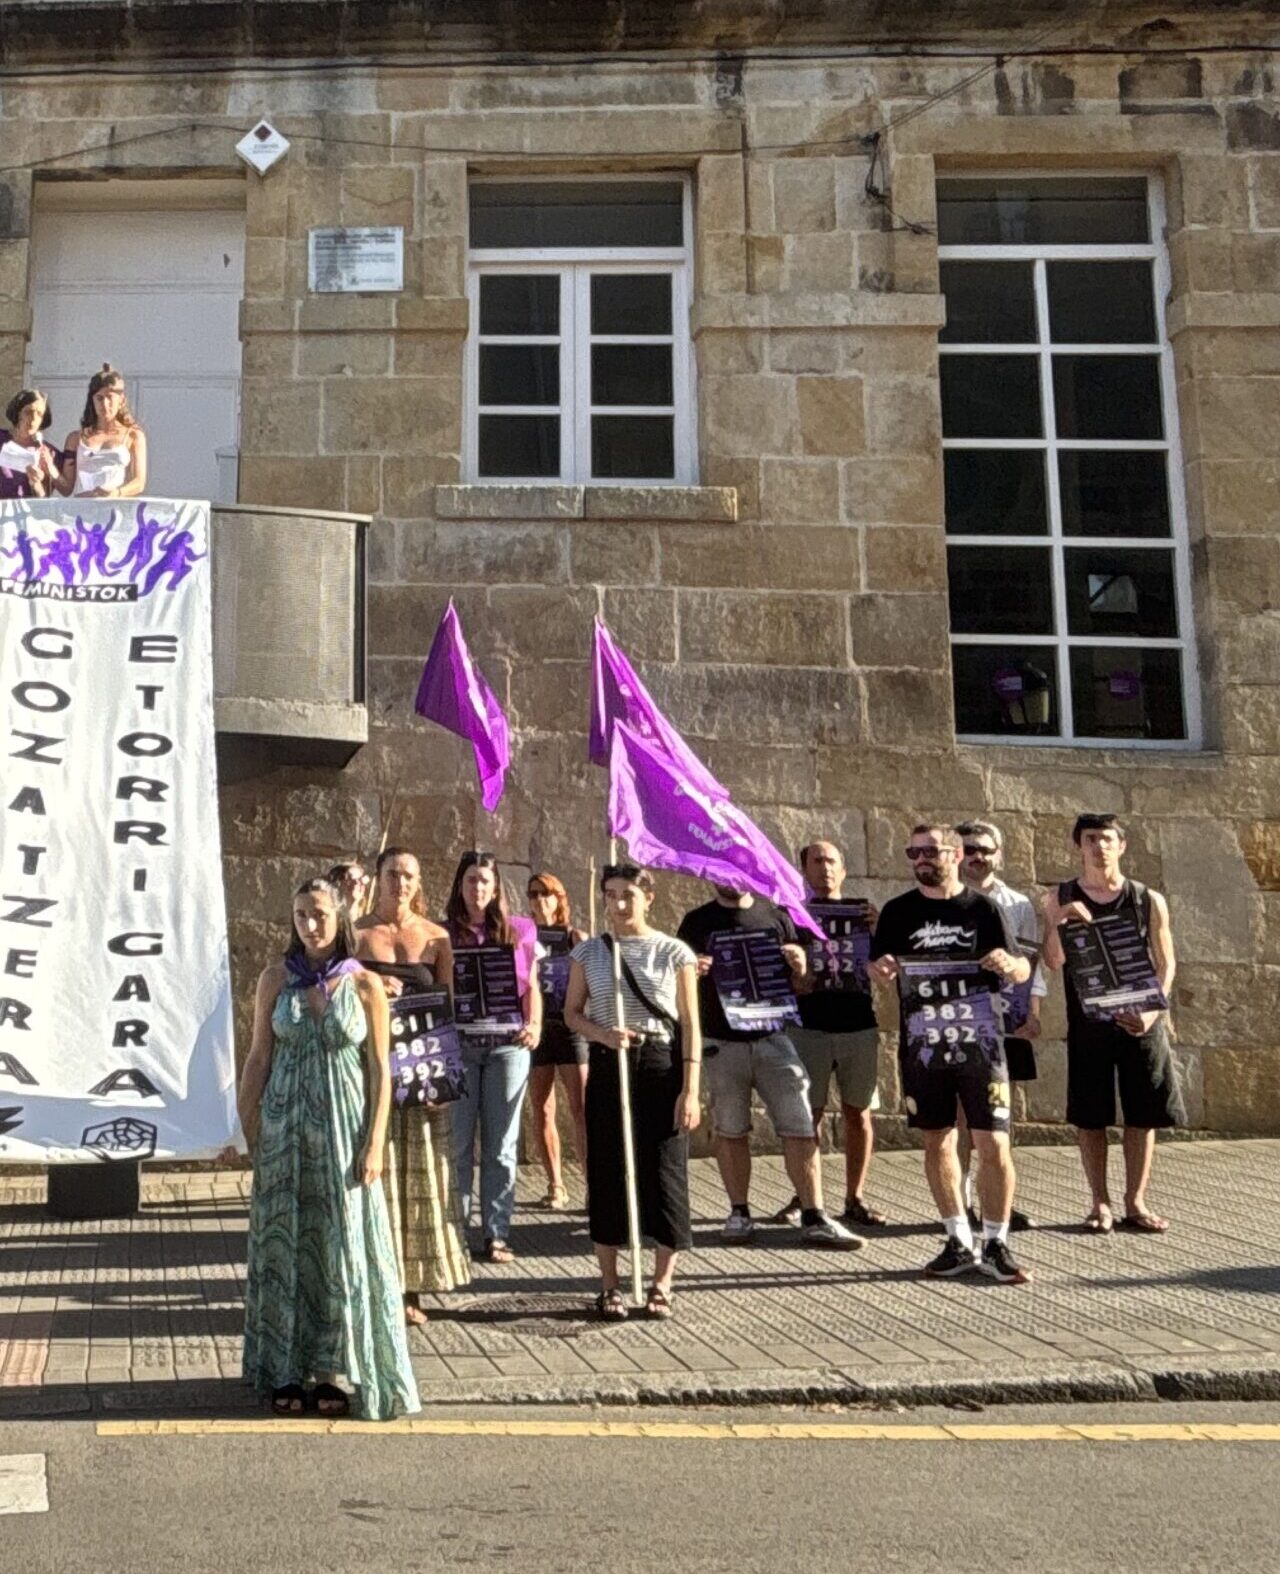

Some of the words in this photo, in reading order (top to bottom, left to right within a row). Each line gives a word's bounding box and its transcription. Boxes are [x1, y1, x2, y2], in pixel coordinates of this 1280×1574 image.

[0, 578, 131, 600] FEMINISTOK
[113, 635, 179, 893] ETORRI
[918, 978, 968, 998] 611
[87, 931, 164, 1098] GARA
[390, 1011, 435, 1036] 611
[922, 1003, 974, 1022] 382
[924, 1026, 977, 1045] 392
[394, 1036, 442, 1060] 382
[400, 1060, 446, 1084] 392
